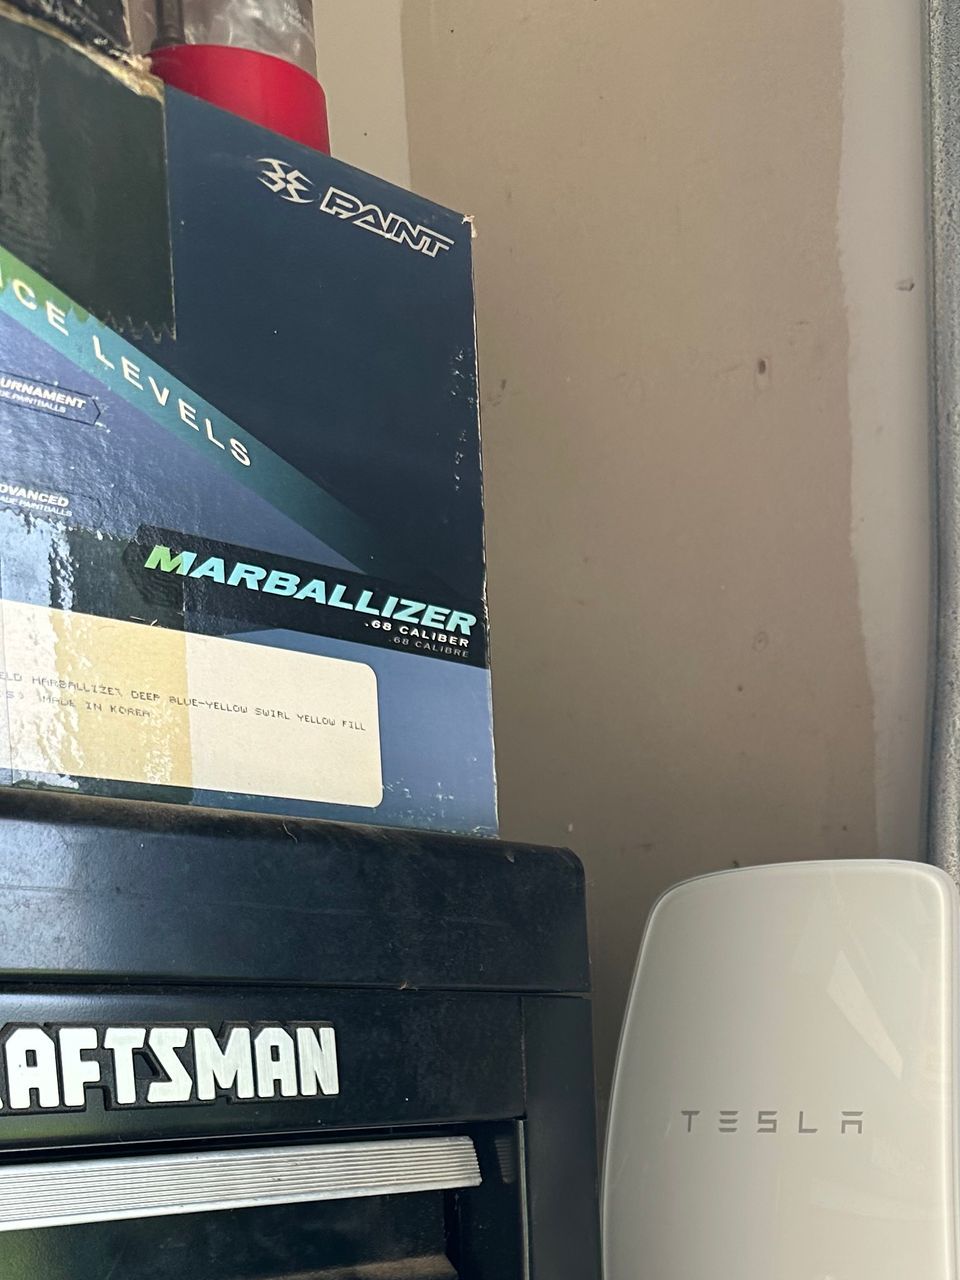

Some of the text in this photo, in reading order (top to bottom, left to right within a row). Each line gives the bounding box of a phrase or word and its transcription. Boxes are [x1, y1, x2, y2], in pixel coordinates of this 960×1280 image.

[320, 187, 455, 258] PAINT
[0, 263, 251, 467] CE LEVELS
[144, 544, 477, 635] MARBALLIZER
[364, 619, 470, 649] .68 CALIBER
[388, 635, 470, 659] .68 CALIBRE
[86, 701, 103, 712] IN
[110, 703, 151, 718] KOREA
[131, 690, 161, 701] DEEP
[169, 696, 248, 714] BLUE-YELLOW
[255, 707, 291, 721] SWIRL
[297, 713, 337, 727] YELLOW
[342, 720, 367, 732] FILL
[0, 1027, 340, 1110] AFTSMAN
[681, 1110, 863, 1134] TESLA
